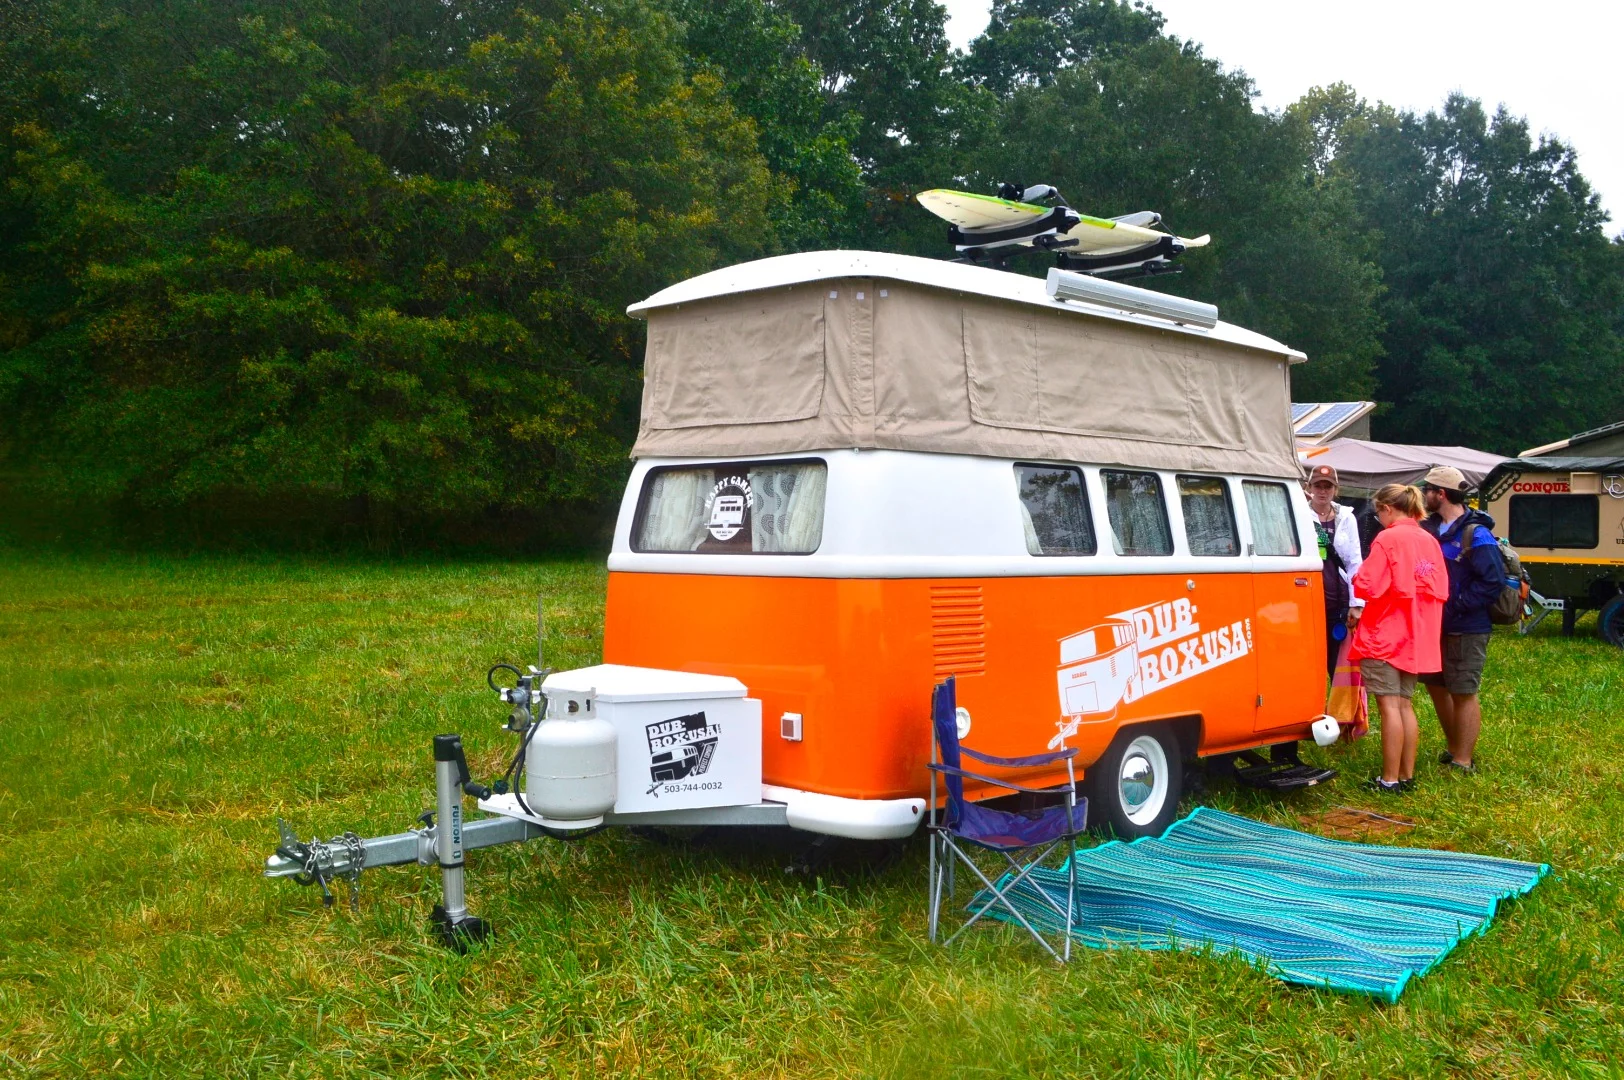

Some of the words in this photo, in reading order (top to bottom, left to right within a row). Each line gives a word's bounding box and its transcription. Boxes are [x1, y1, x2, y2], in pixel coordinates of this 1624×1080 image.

[705, 476, 728, 509] HAPPY
[730, 475, 754, 508] CAMPER
[664, 781, 723, 794] 503-744-0032
[452, 805, 461, 844] FULTON
